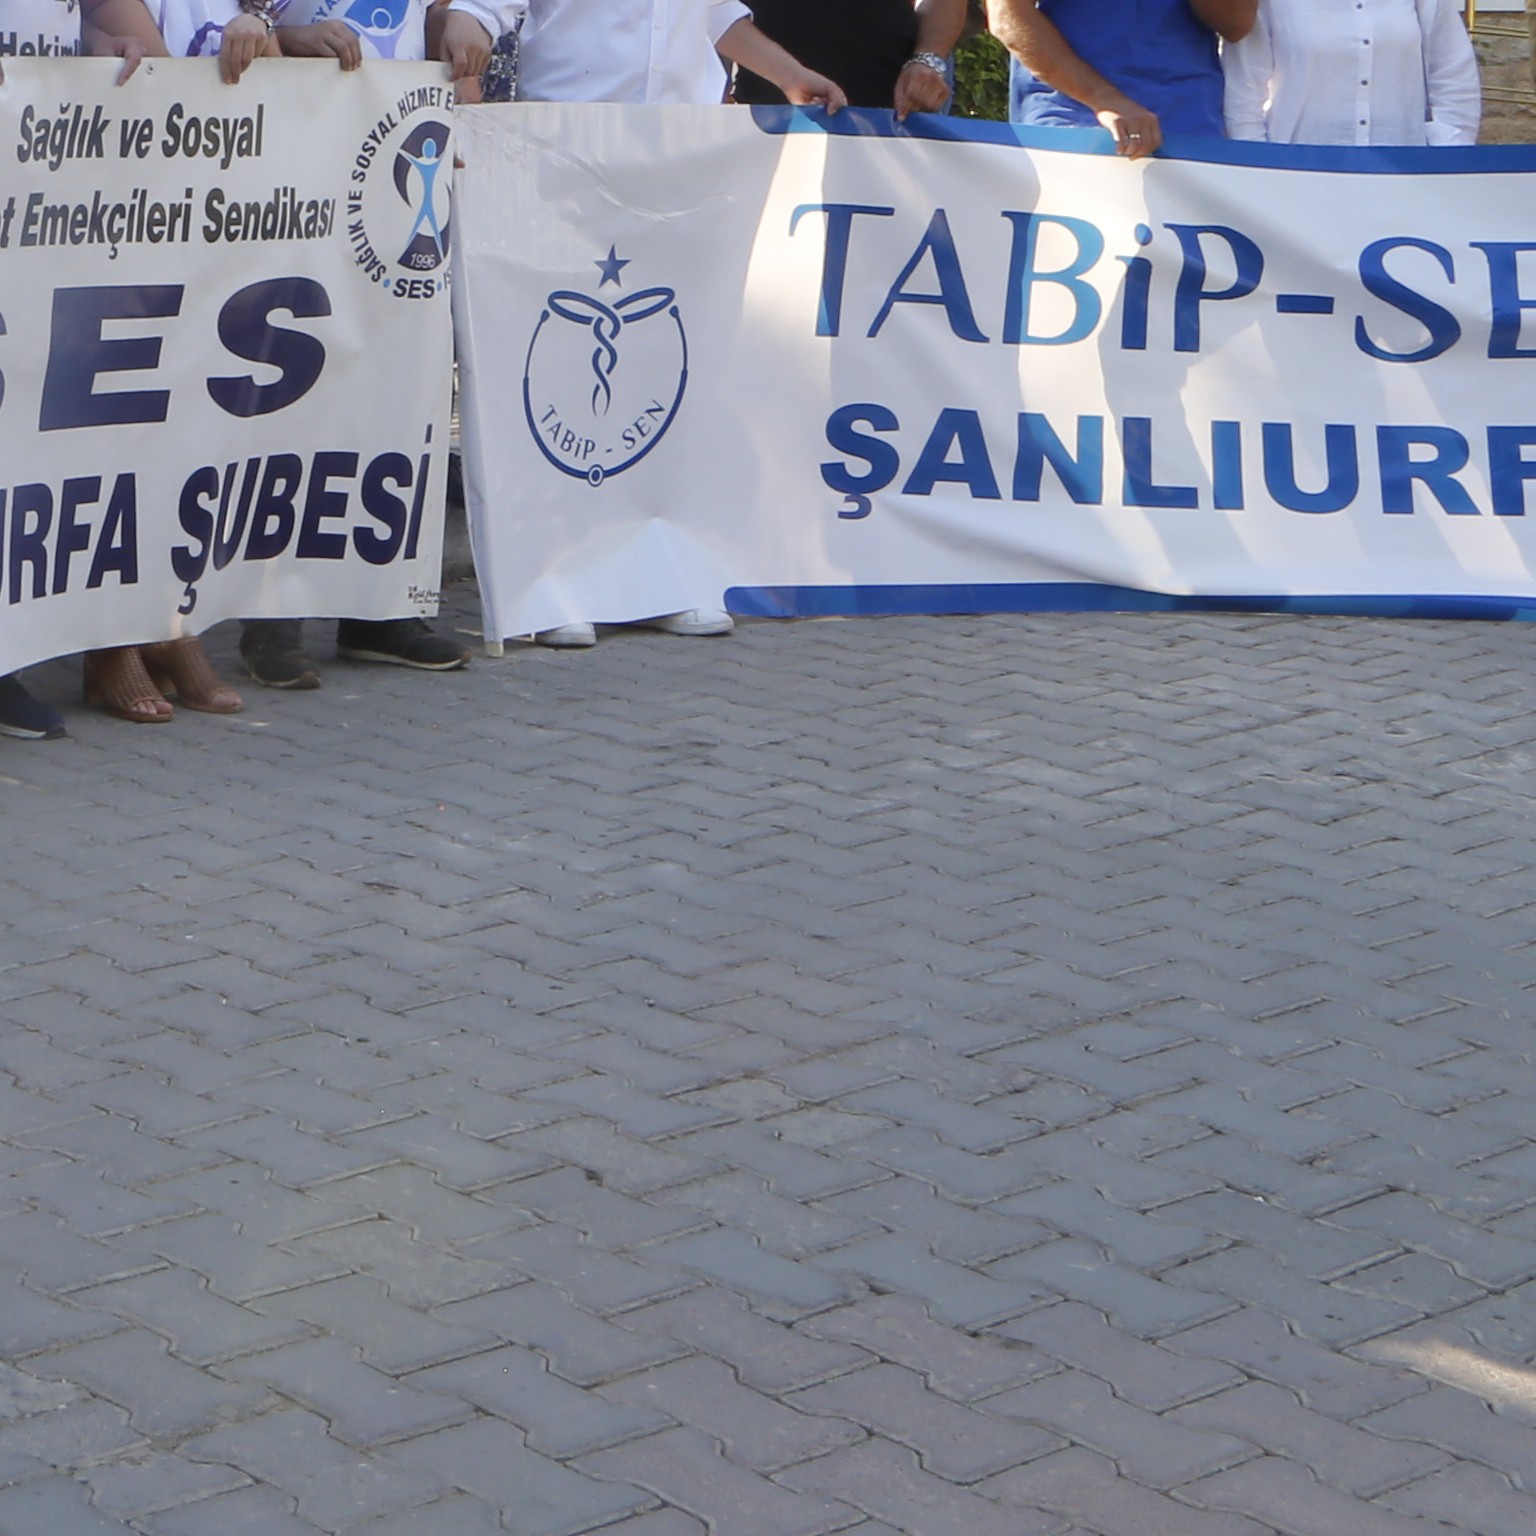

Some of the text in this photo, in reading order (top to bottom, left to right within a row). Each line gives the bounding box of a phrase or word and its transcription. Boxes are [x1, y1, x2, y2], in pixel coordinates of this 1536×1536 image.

[397, 86, 443, 121] HİZMET
[16, 102, 264, 172] Sağlık ve Sosyal
[351, 112, 398, 183] SOSYAL
[20, 188, 193, 260] Emekçileri
[202, 185, 336, 244] Sendikası
[348, 189, 363, 215] VE
[347, 218, 387, 283] SAĞLIK
[409, 253, 436, 268] 1996
[393, 277, 436, 299] SES
[622, 399, 665, 450] SEN
[170, 423, 434, 615] ŞUBESİ
